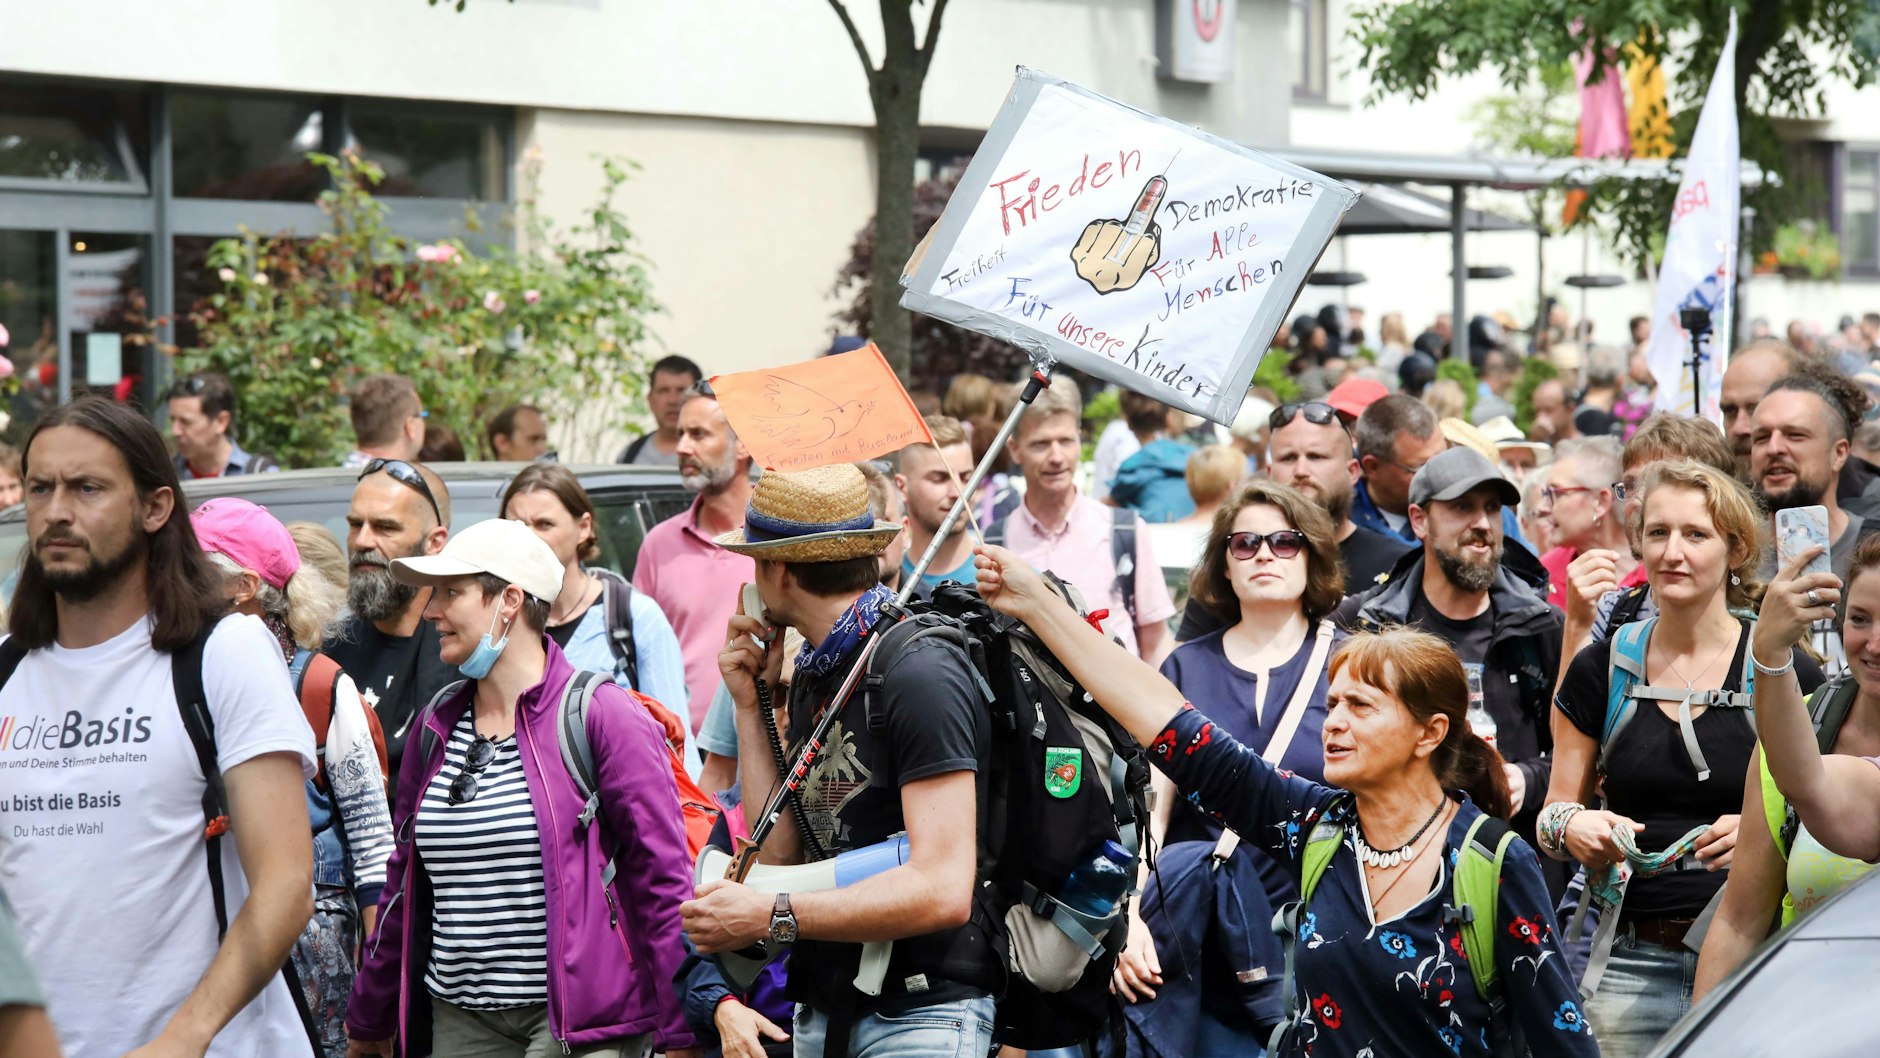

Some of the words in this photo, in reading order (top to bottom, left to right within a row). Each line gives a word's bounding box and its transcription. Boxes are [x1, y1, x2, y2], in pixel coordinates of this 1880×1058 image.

[989, 149, 1141, 237] Frieden
[940, 243, 1009, 292] Freiheit
[1150, 258, 1196, 288] Für
[1206, 222, 1262, 262] Alle
[1157, 259, 1284, 322] Menschen
[1004, 277, 1054, 322] Für
[1057, 311, 1125, 359] unsere
[1123, 322, 1210, 399] Kinder
[766, 452, 823, 467] Frieden
[831, 444, 851, 457] mit
[9, 757, 29, 769] und
[31, 757, 60, 769] Deine
[62, 755, 97, 769] Stimme
[99, 752, 148, 764] behalten
[787, 737, 821, 792] LEKI
[0, 800, 9, 812] u
[13, 794, 44, 812] bist
[48, 793, 74, 810] die
[78, 790, 121, 809] Basis
[14, 825, 29, 838] Du
[32, 824, 55, 837] hast
[57, 823, 74, 836] die
[76, 821, 104, 835] Wahl
